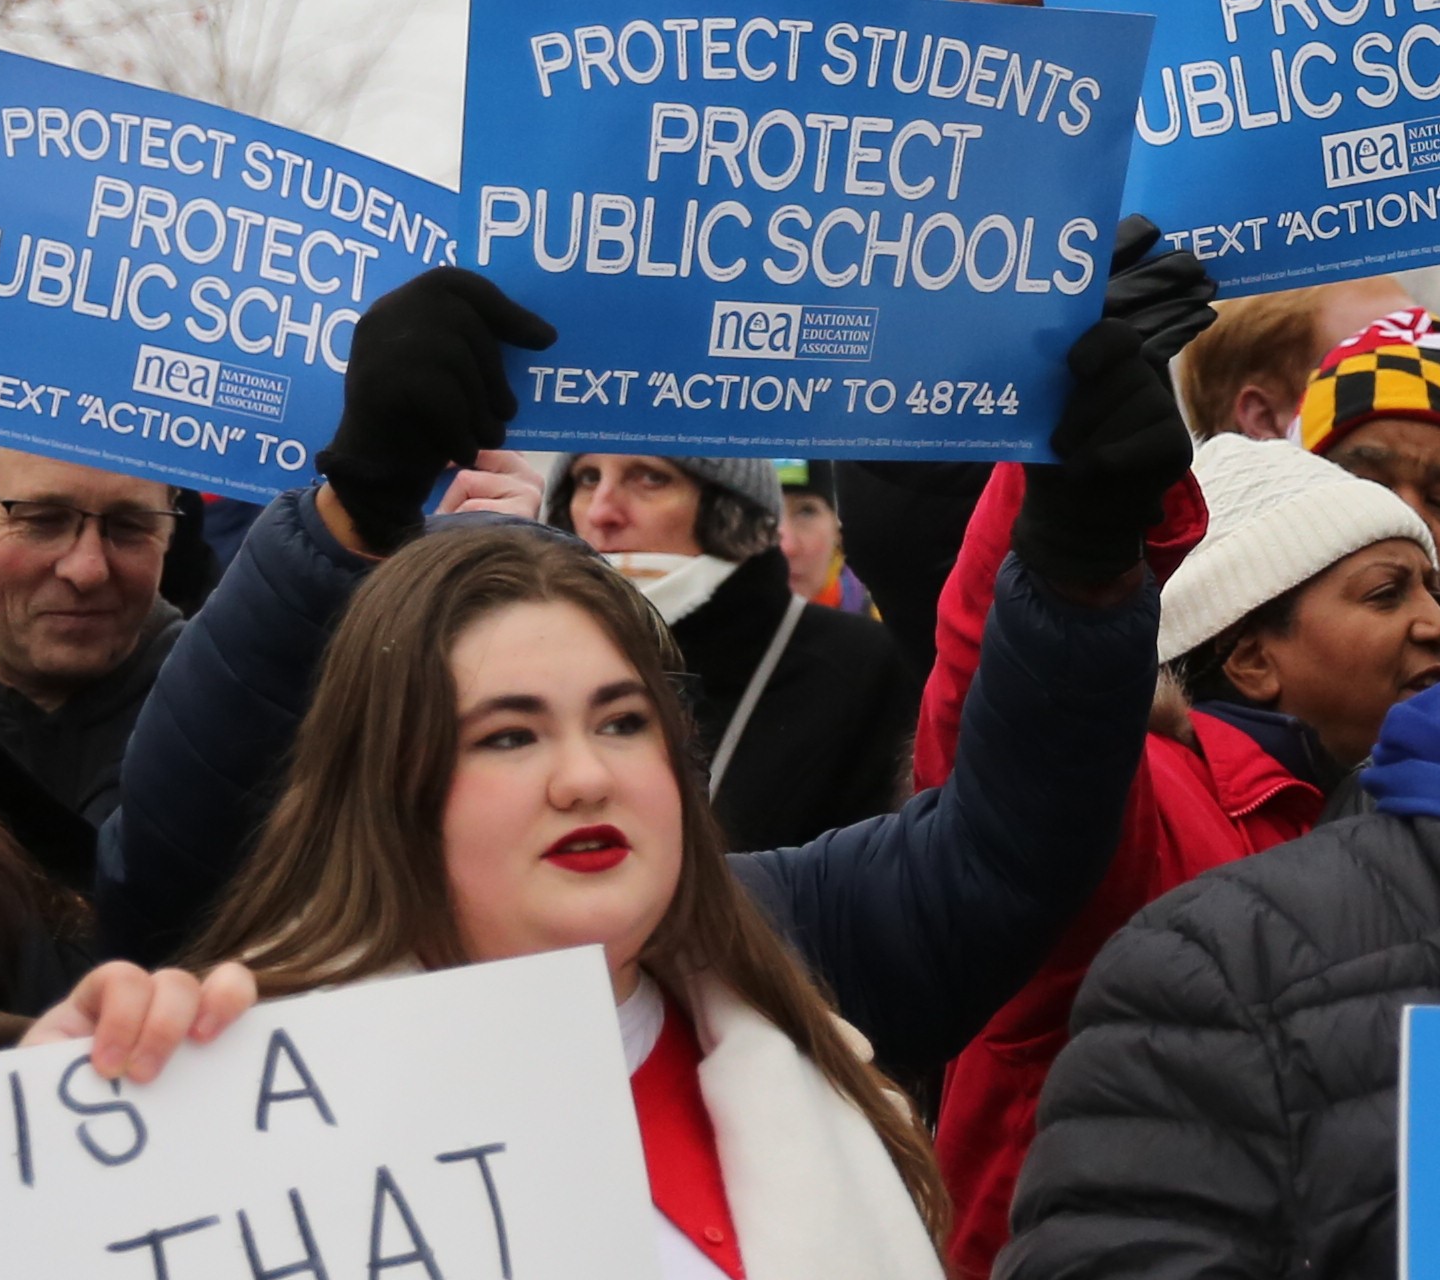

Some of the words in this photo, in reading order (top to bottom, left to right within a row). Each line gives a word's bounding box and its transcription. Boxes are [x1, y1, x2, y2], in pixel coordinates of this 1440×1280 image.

[530, 18, 812, 97] PROTECT
[822, 23, 1101, 138] STUDENTS
[1136, 40, 1343, 146] UBLIC
[1, 107, 236, 180] PROTECT
[648, 103, 984, 200] PROTECT
[1330, 125, 1406, 187] nea
[87, 175, 379, 302] PROTECT
[477, 186, 752, 281] PUBLIC
[764, 205, 1099, 296] SCHOOLS
[1165, 217, 1268, 263] TEXT
[184, 276, 361, 374] SCHO
[714, 305, 793, 355] nea
[803, 312, 873, 328] NATIONAL
[800, 342, 870, 357] ASSOCIATION
[802, 328, 871, 343] EDUCATION
[140, 347, 215, 400] nea
[220, 369, 284, 394] NATIONAL
[216, 394, 280, 418] ASSOCIATION
[219, 381, 282, 406] EDUCATION
[528, 367, 638, 406] TEXT
[648, 371, 830, 412] "ACTION"
[844, 381, 895, 416] TO
[906, 382, 1020, 418] 48744
[77, 393, 246, 456] "ACTION"
[255, 433, 307, 471] TO
[6, 1055, 152, 1186] IS
[254, 1028, 339, 1134] A
